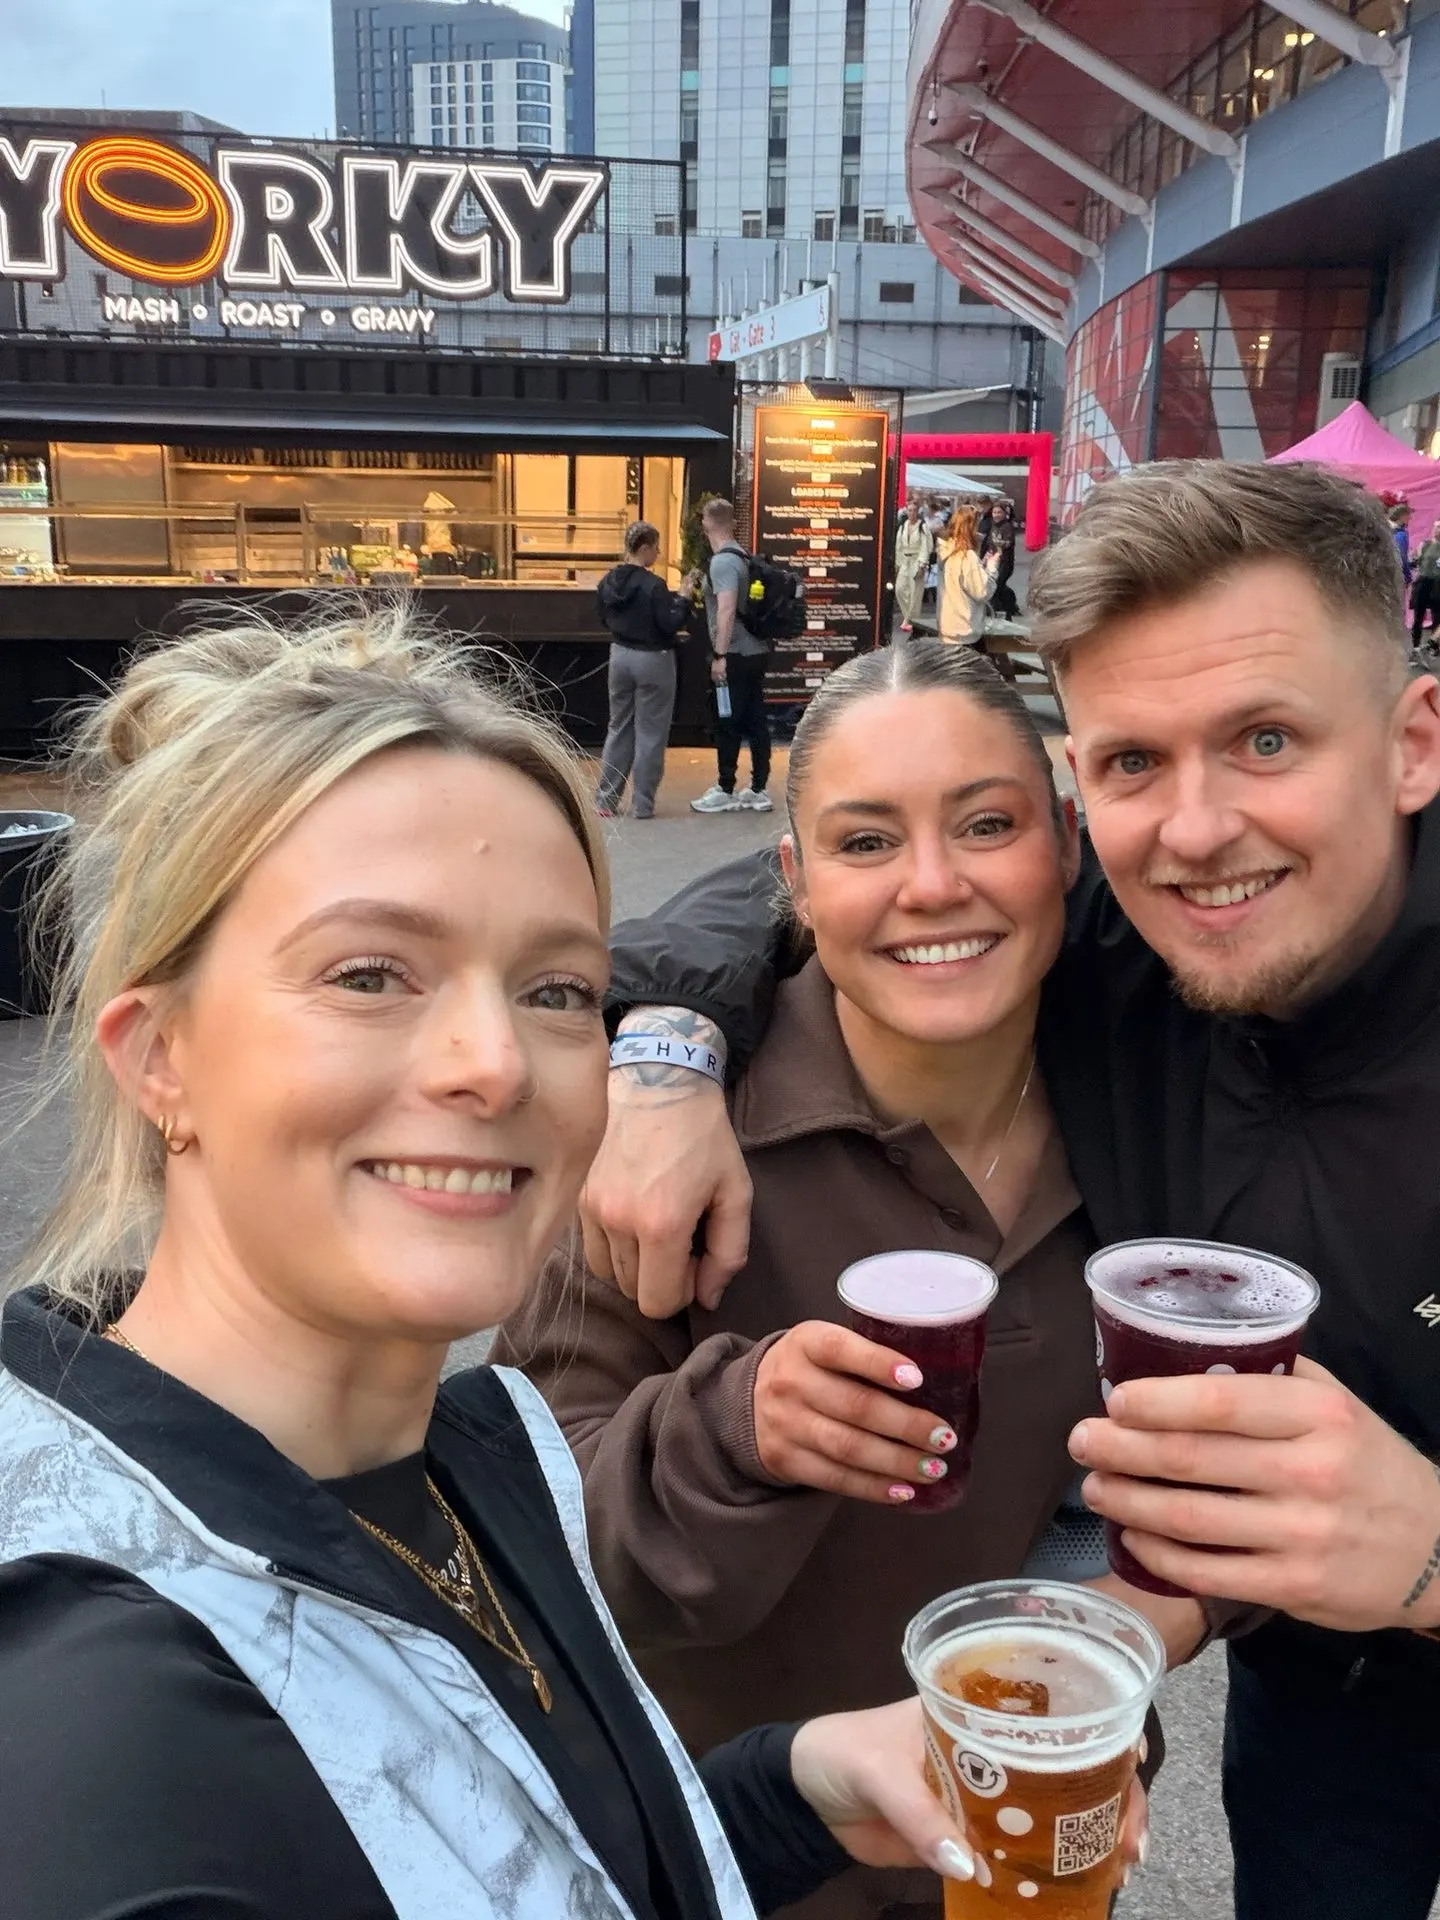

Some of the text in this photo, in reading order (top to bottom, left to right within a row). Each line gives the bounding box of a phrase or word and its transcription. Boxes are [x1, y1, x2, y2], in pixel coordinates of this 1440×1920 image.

[0, 137, 605, 300] YORKY
[105, 296, 435, 333] MASH ROAST GRAVY
[657, 1041, 724, 1078] HYR
